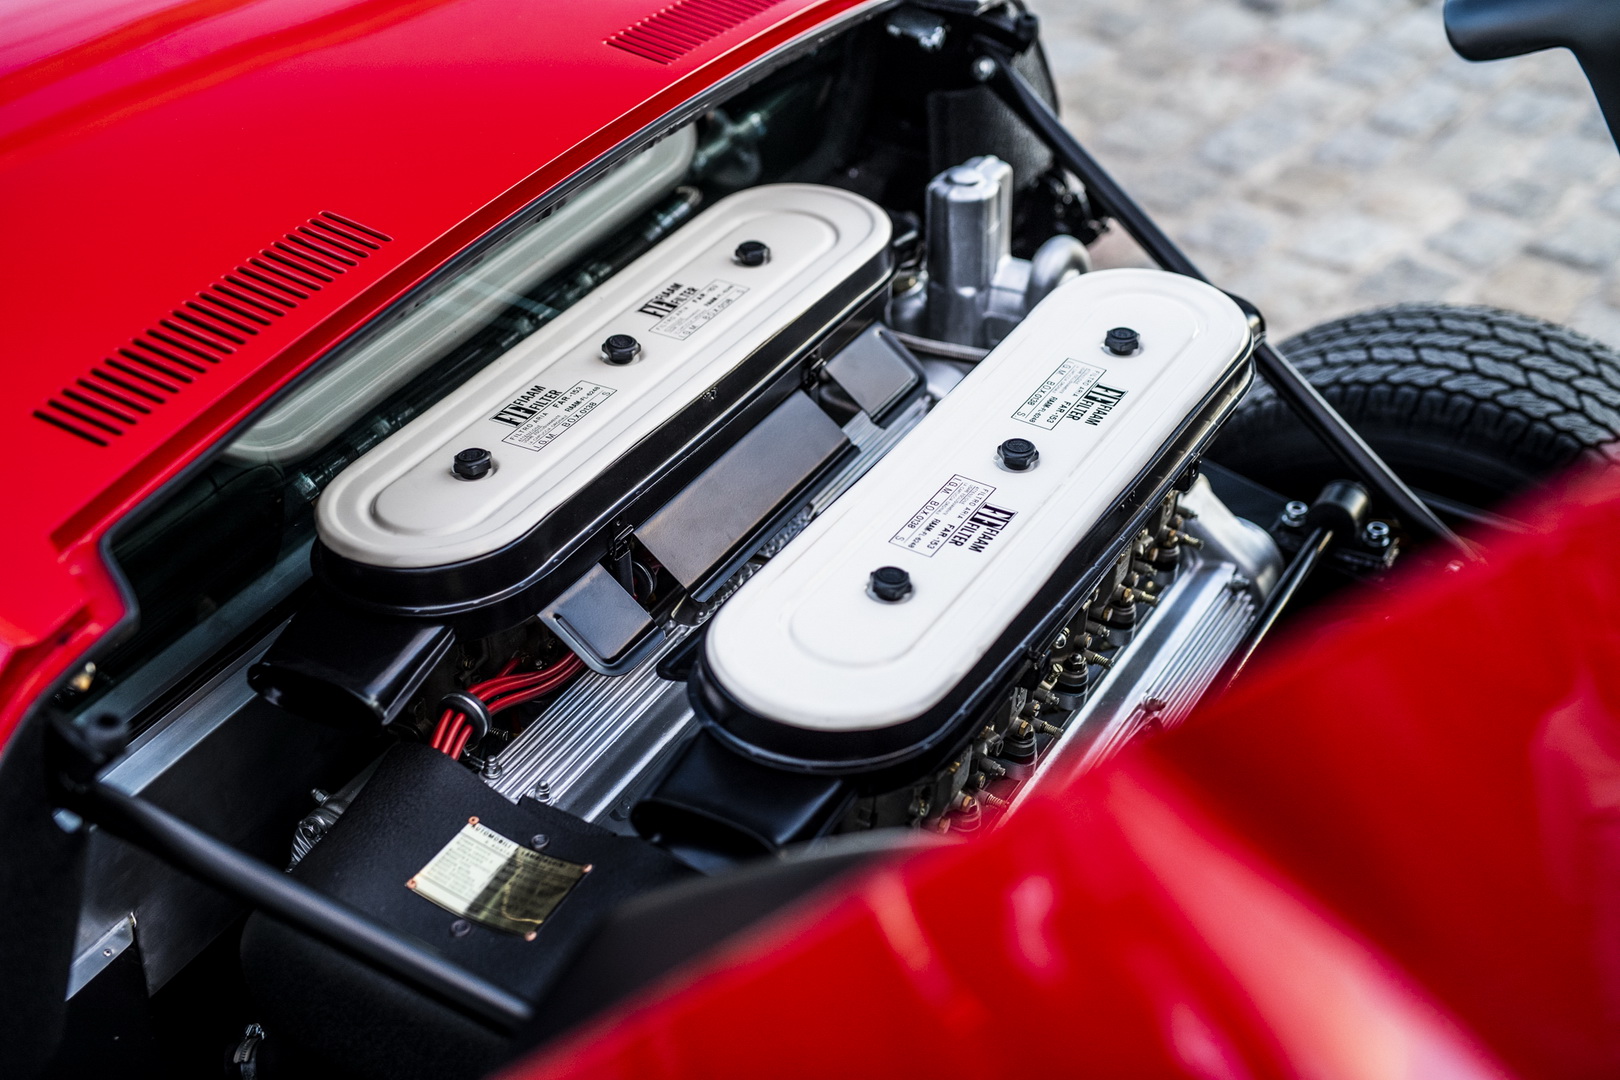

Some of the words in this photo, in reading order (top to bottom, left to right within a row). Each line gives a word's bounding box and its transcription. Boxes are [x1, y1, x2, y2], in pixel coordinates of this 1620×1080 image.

[654, 282, 684, 300] FIAAM
[669, 286, 699, 304] FILTER
[1081, 370, 1100, 386] FILTRO
[511, 384, 546, 406] FIAAM
[527, 389, 562, 410] FILTER
[1071, 386, 1085, 397] ARIA
[1065, 399, 1094, 421] FILTER
[1084, 404, 1112, 426] FIAAM
[508, 423, 534, 440] FILTRO
[531, 411, 548, 423] ARIA
[967, 488, 989, 506] FILTRO
[956, 506, 971, 519] ARIA
[947, 521, 980, 547] FILTER
[967, 527, 999, 553] FIAAM
